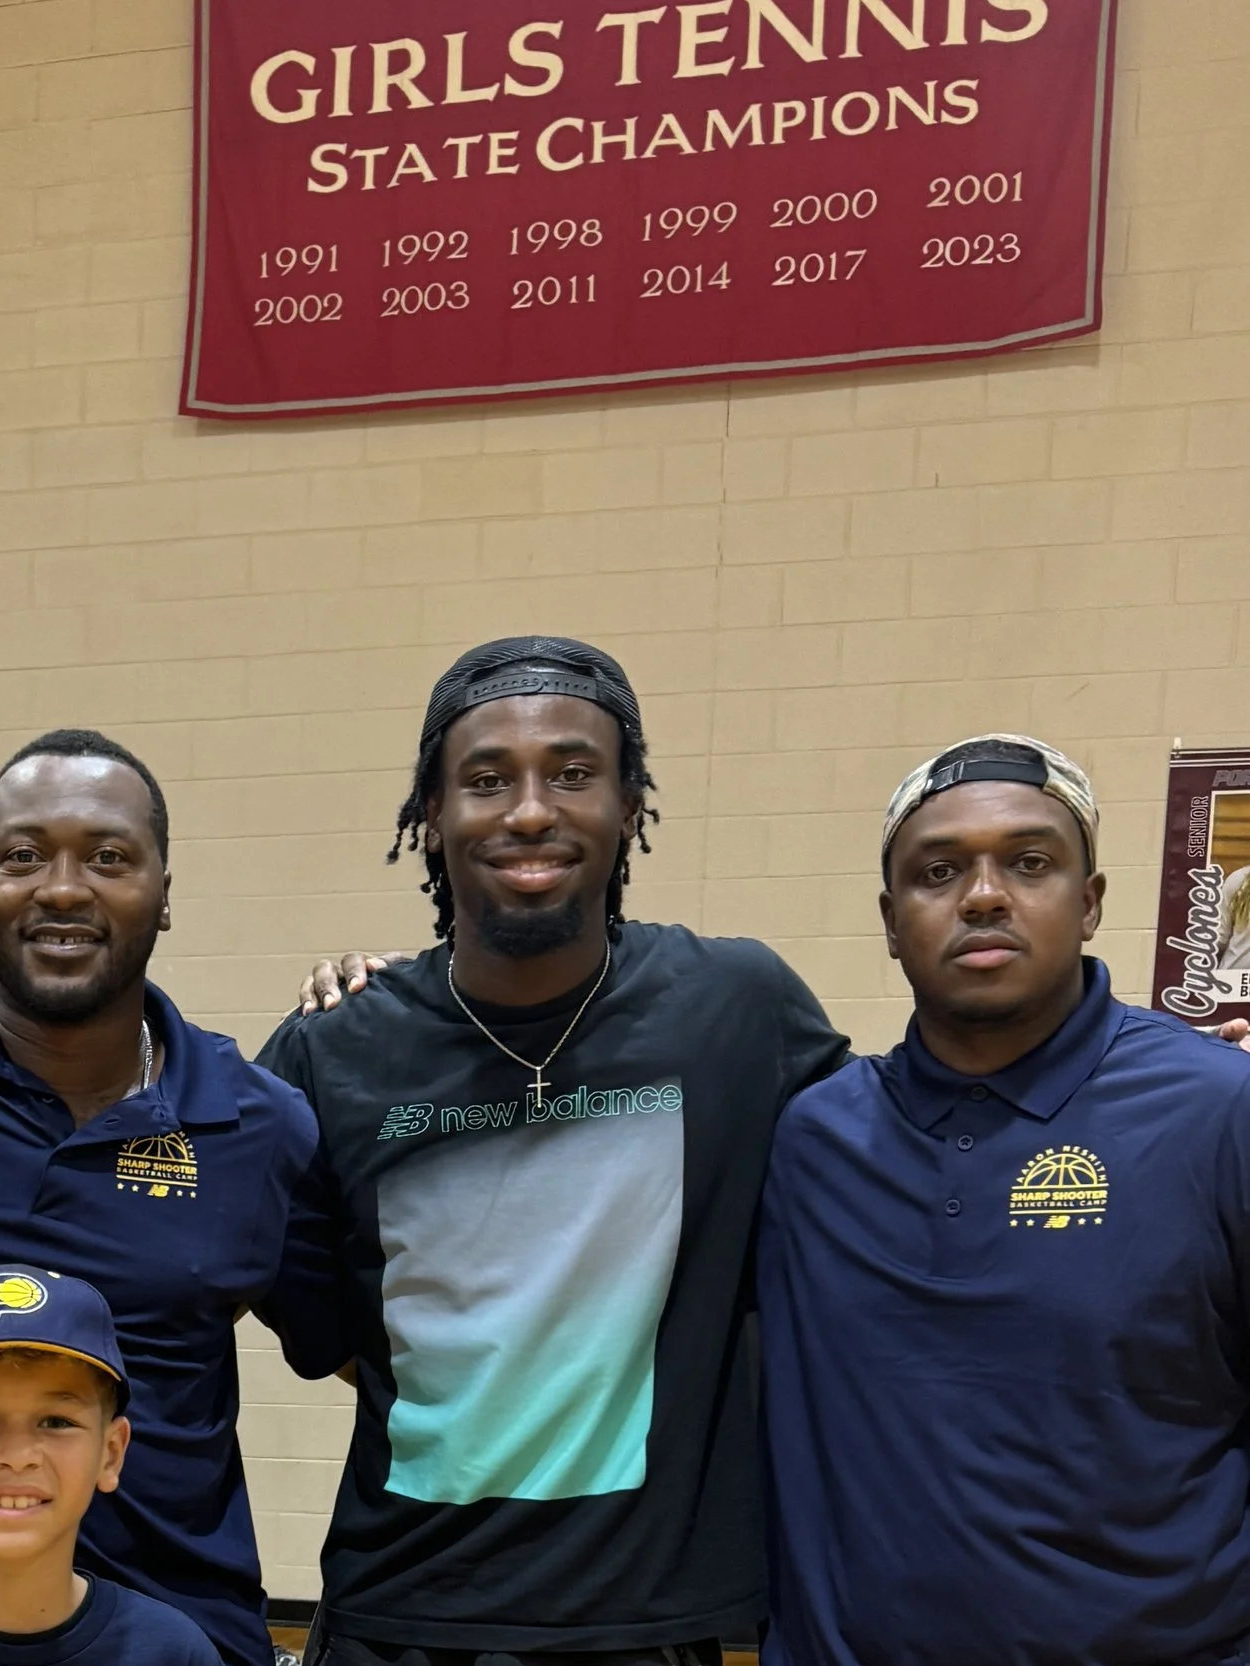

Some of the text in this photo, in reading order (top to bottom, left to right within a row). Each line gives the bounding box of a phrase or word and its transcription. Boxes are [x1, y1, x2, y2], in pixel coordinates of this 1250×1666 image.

[250, 0, 1049, 125] GIRLS TENNIS
[307, 79, 980, 194] STATE CHAMPIONS
[260, 171, 1023, 279] 1991 1992 1998 1999 2000 2001
[254, 232, 1021, 326] 2002 2003 2011 2014 2017 2023
[1188, 795, 1209, 858] SENIOR
[1161, 864, 1233, 1017] Cyclones
[441, 1101, 518, 1133] new
[526, 1084, 683, 1123] balance
[117, 1158, 197, 1175] SHARP SHOOTER
[117, 1167, 172, 1179] BASKETBALL
[1010, 1190, 1108, 1201] SHARP SHOOTER
